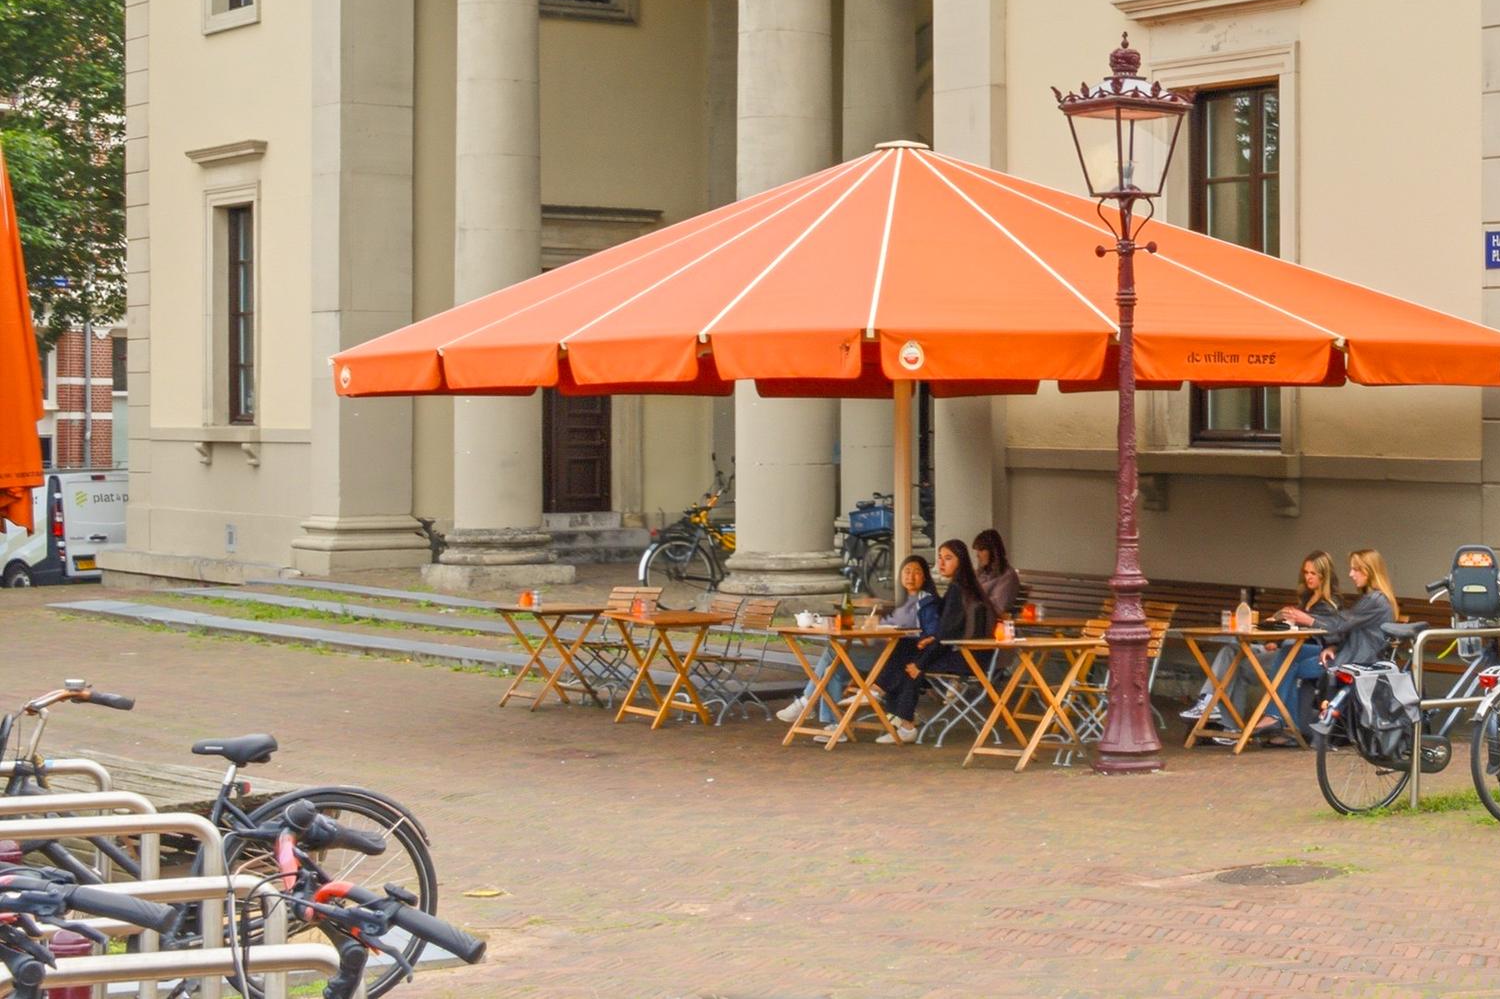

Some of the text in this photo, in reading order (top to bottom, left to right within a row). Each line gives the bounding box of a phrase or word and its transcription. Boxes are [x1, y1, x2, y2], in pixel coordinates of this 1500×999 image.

[1187, 351, 1277, 365] de willem CAFÉ
